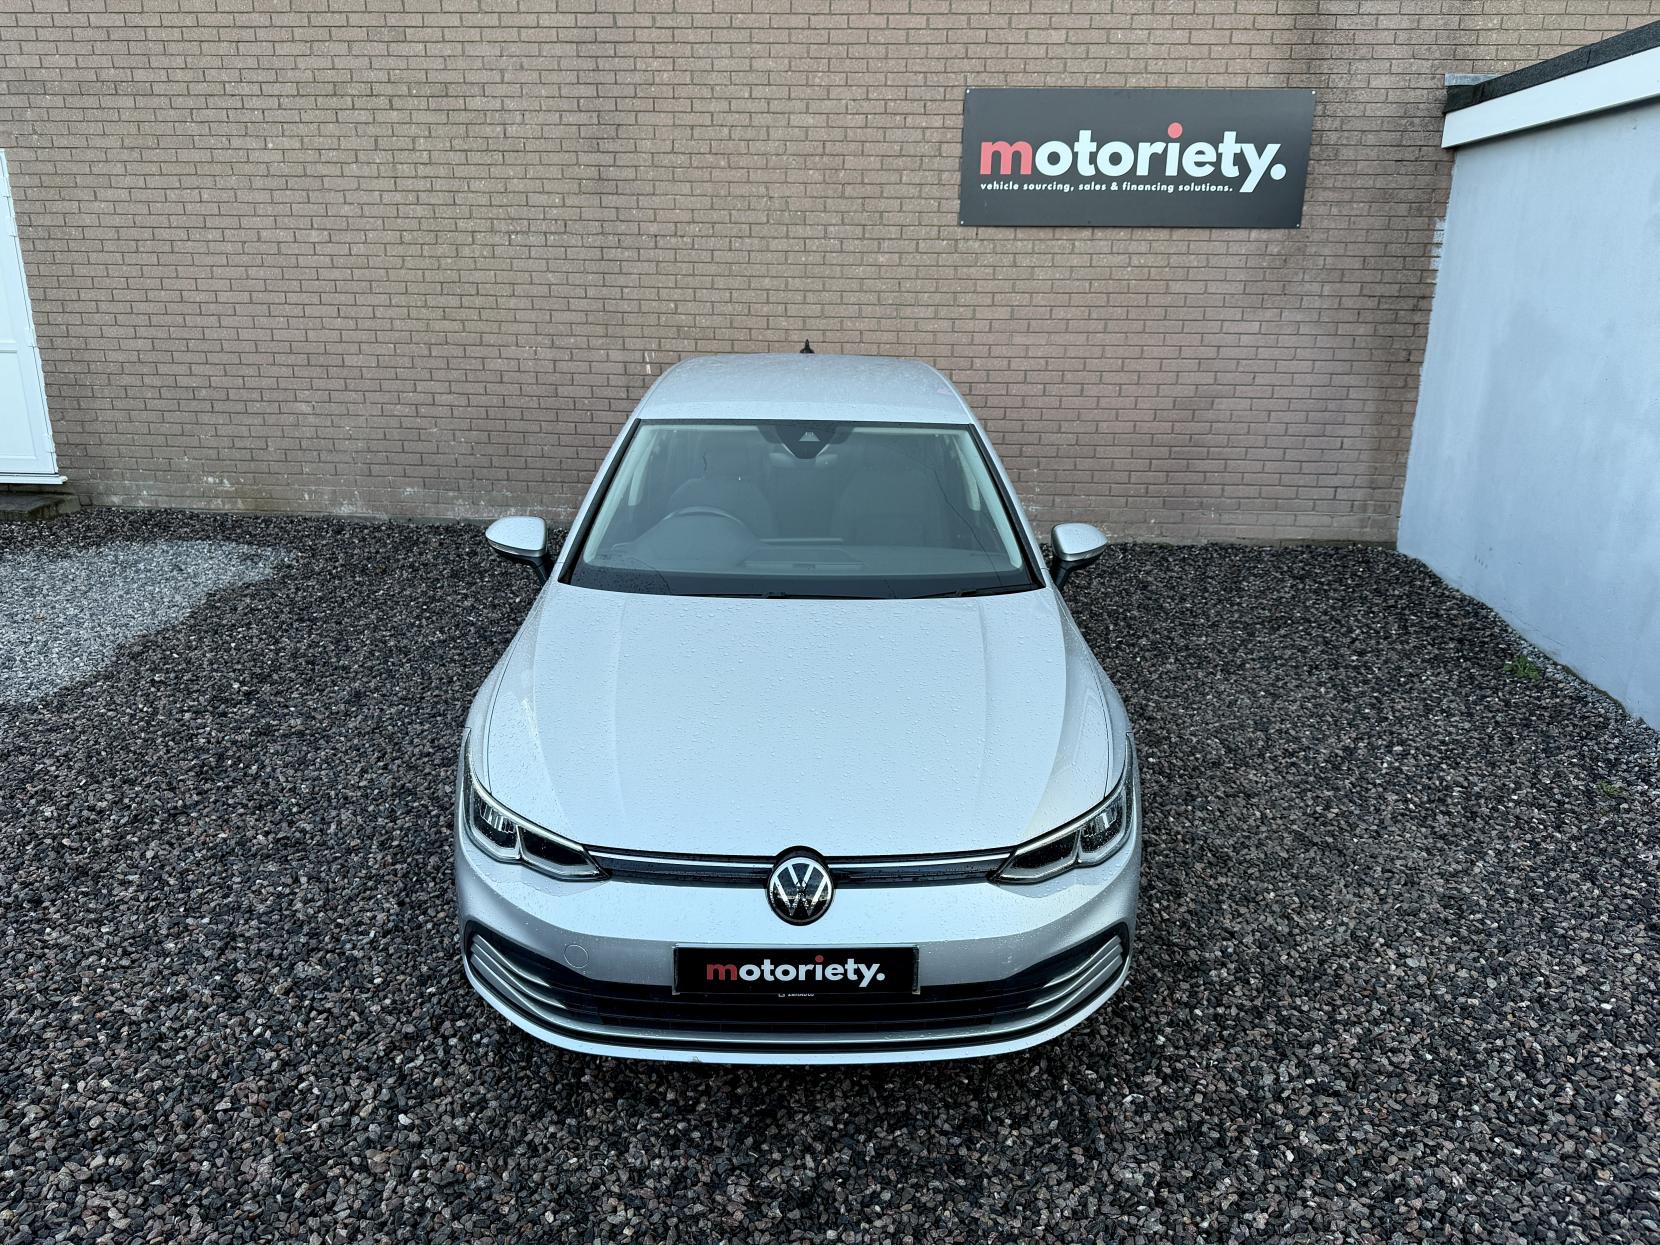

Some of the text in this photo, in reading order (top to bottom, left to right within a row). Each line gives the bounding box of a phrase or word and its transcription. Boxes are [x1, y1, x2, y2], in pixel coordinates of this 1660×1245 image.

[980, 122, 1287, 193] motoriety.
[980, 182, 1233, 193] vehicle sourcing, sales & financing solutions.
[706, 954, 885, 987] motoriety.
